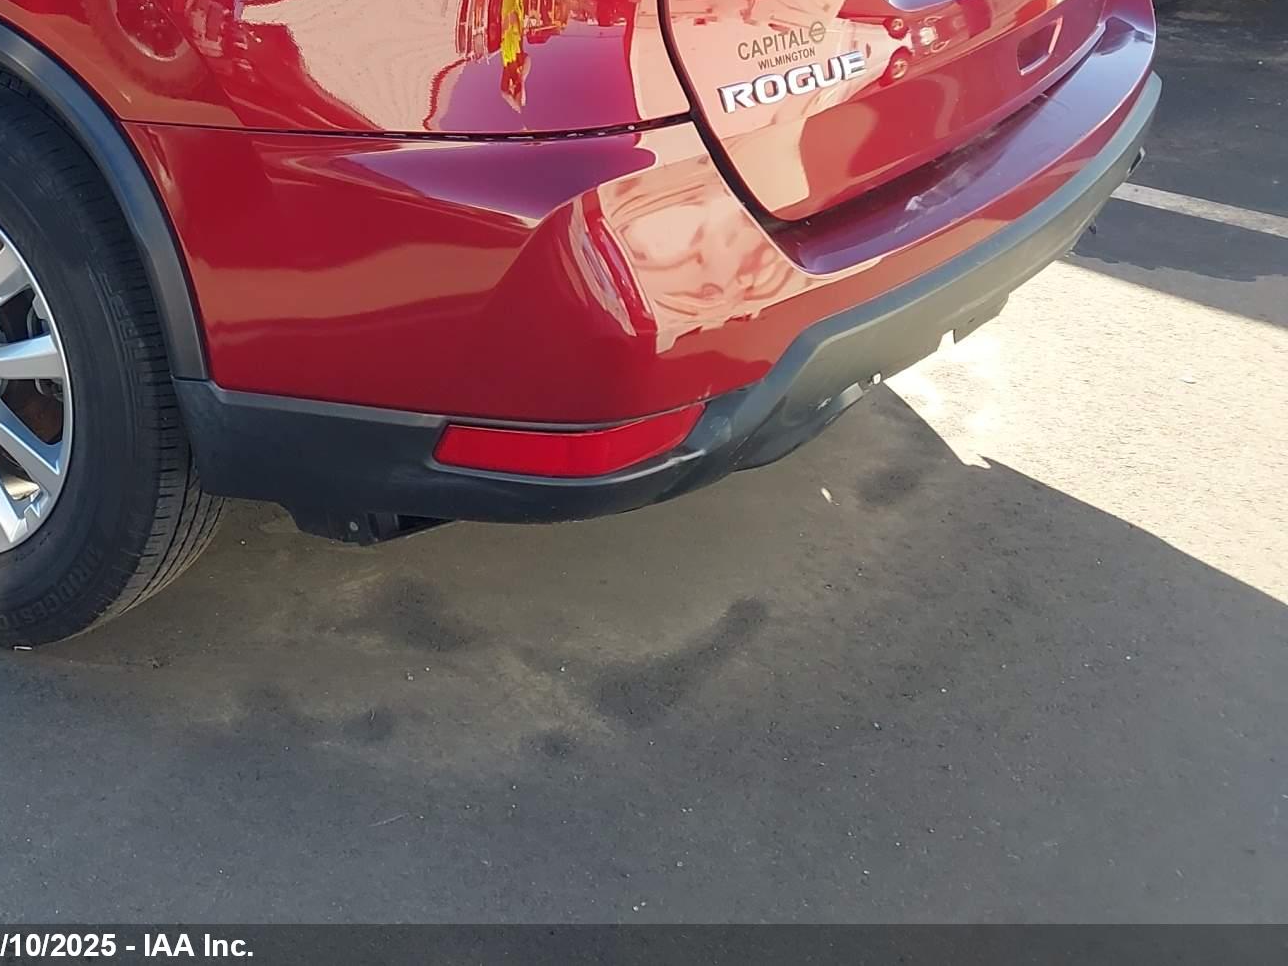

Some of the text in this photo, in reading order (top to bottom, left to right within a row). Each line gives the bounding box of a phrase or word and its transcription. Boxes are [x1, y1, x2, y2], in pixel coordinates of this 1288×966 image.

[737, 28, 810, 60] CAPITAL
[758, 46, 816, 70] WILMINGTON
[717, 51, 866, 113] ROGUE
